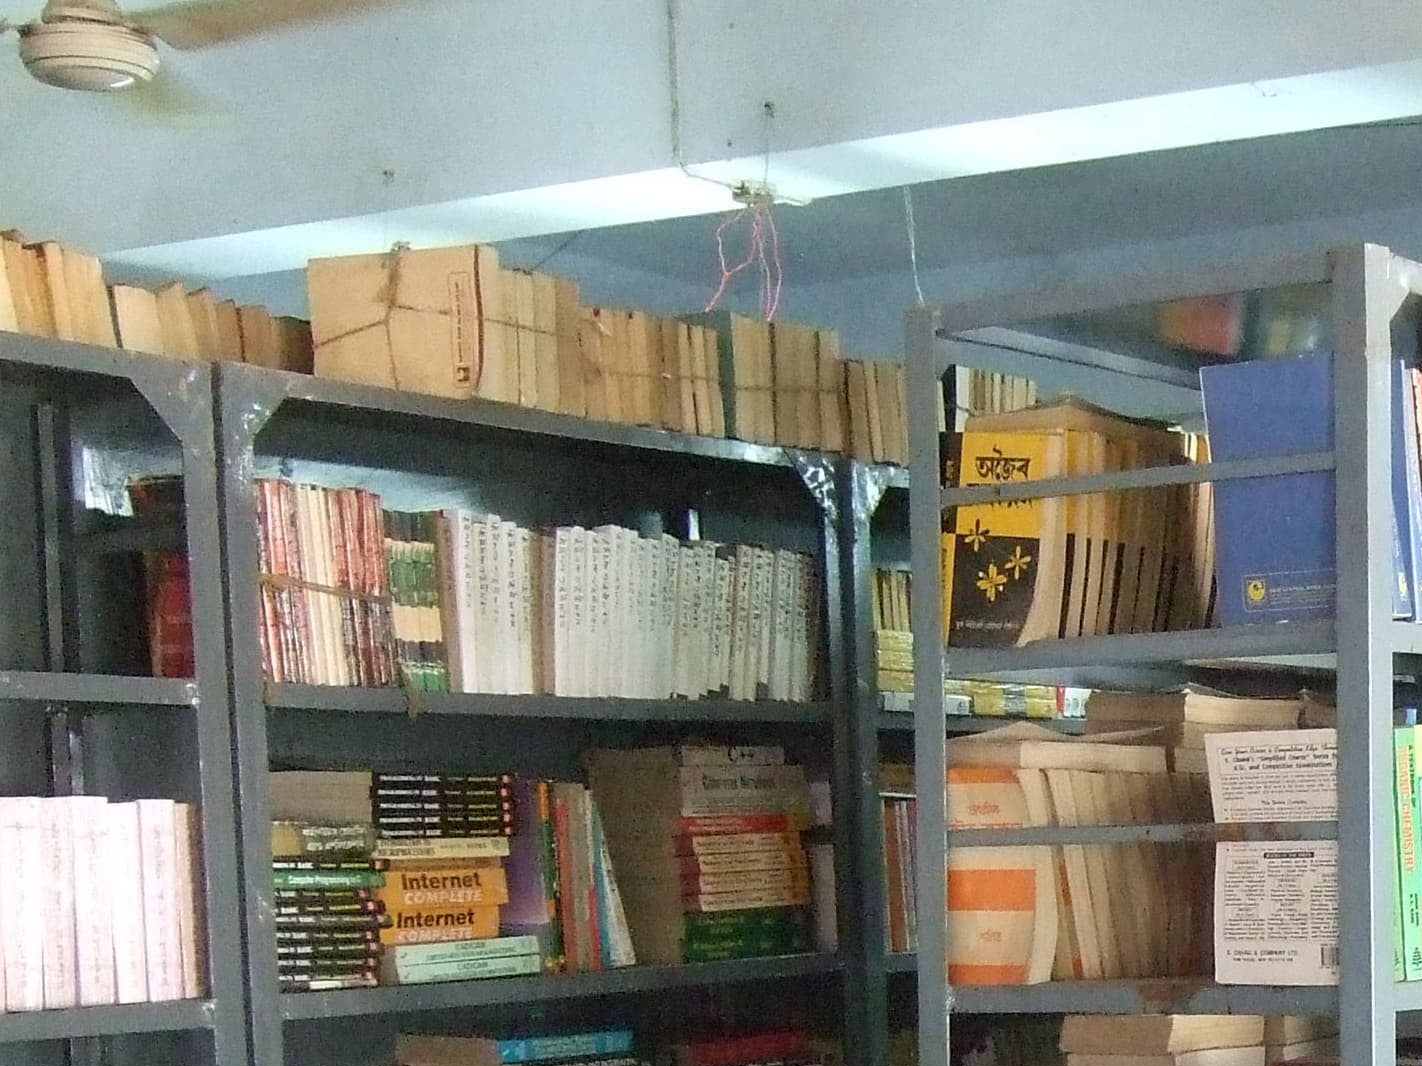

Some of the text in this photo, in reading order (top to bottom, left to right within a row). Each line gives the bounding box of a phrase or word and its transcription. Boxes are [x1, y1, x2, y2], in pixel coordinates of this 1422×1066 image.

[975, 444, 1031, 481] অজৈব
[1401, 802, 1415, 873] CHEMISTRY
[400, 872, 482, 890] Internet
[403, 890, 483, 905] COMPLETE
[397, 909, 475, 929] Internet
[395, 926, 473, 942] COMPLETE
